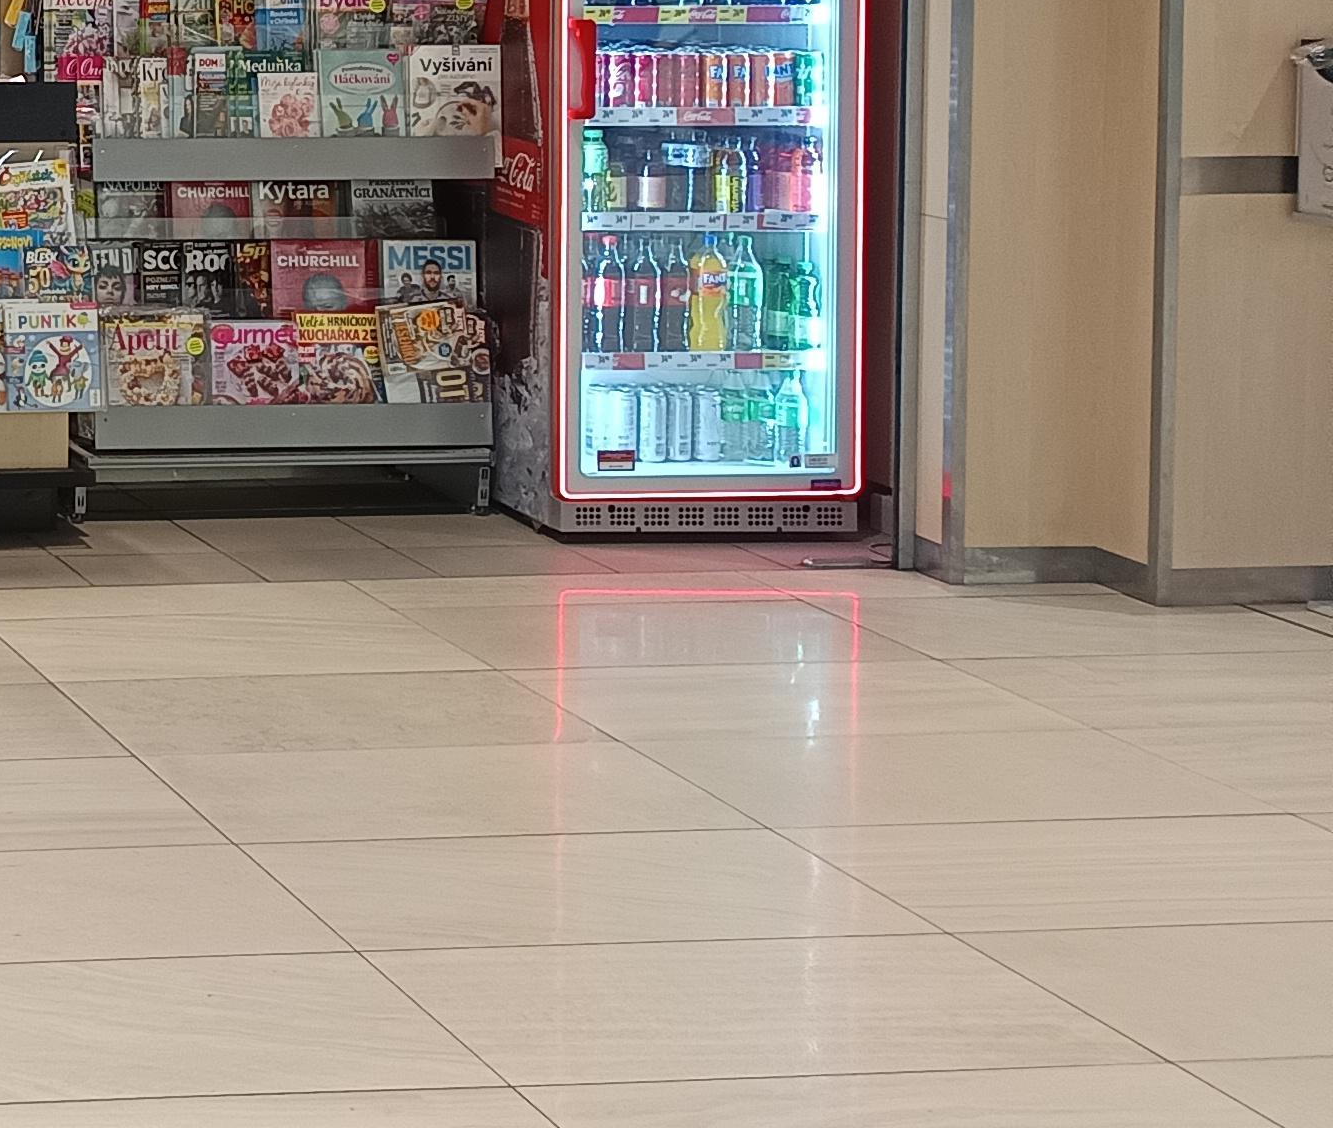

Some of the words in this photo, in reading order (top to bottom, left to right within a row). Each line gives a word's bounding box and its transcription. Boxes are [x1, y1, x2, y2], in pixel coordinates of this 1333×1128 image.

[420, 57, 493, 76] Vyšívání
[177, 185, 250, 199] CHURCHILL
[259, 180, 330, 205] Kytara
[353, 183, 432, 200] GRANÁTNÍCI
[277, 254, 360, 268] CHURCHILL
[388, 245, 472, 270] MESSI
[111, 322, 180, 357] Apetit
[298, 326, 360, 343] KUCHAŘKA
